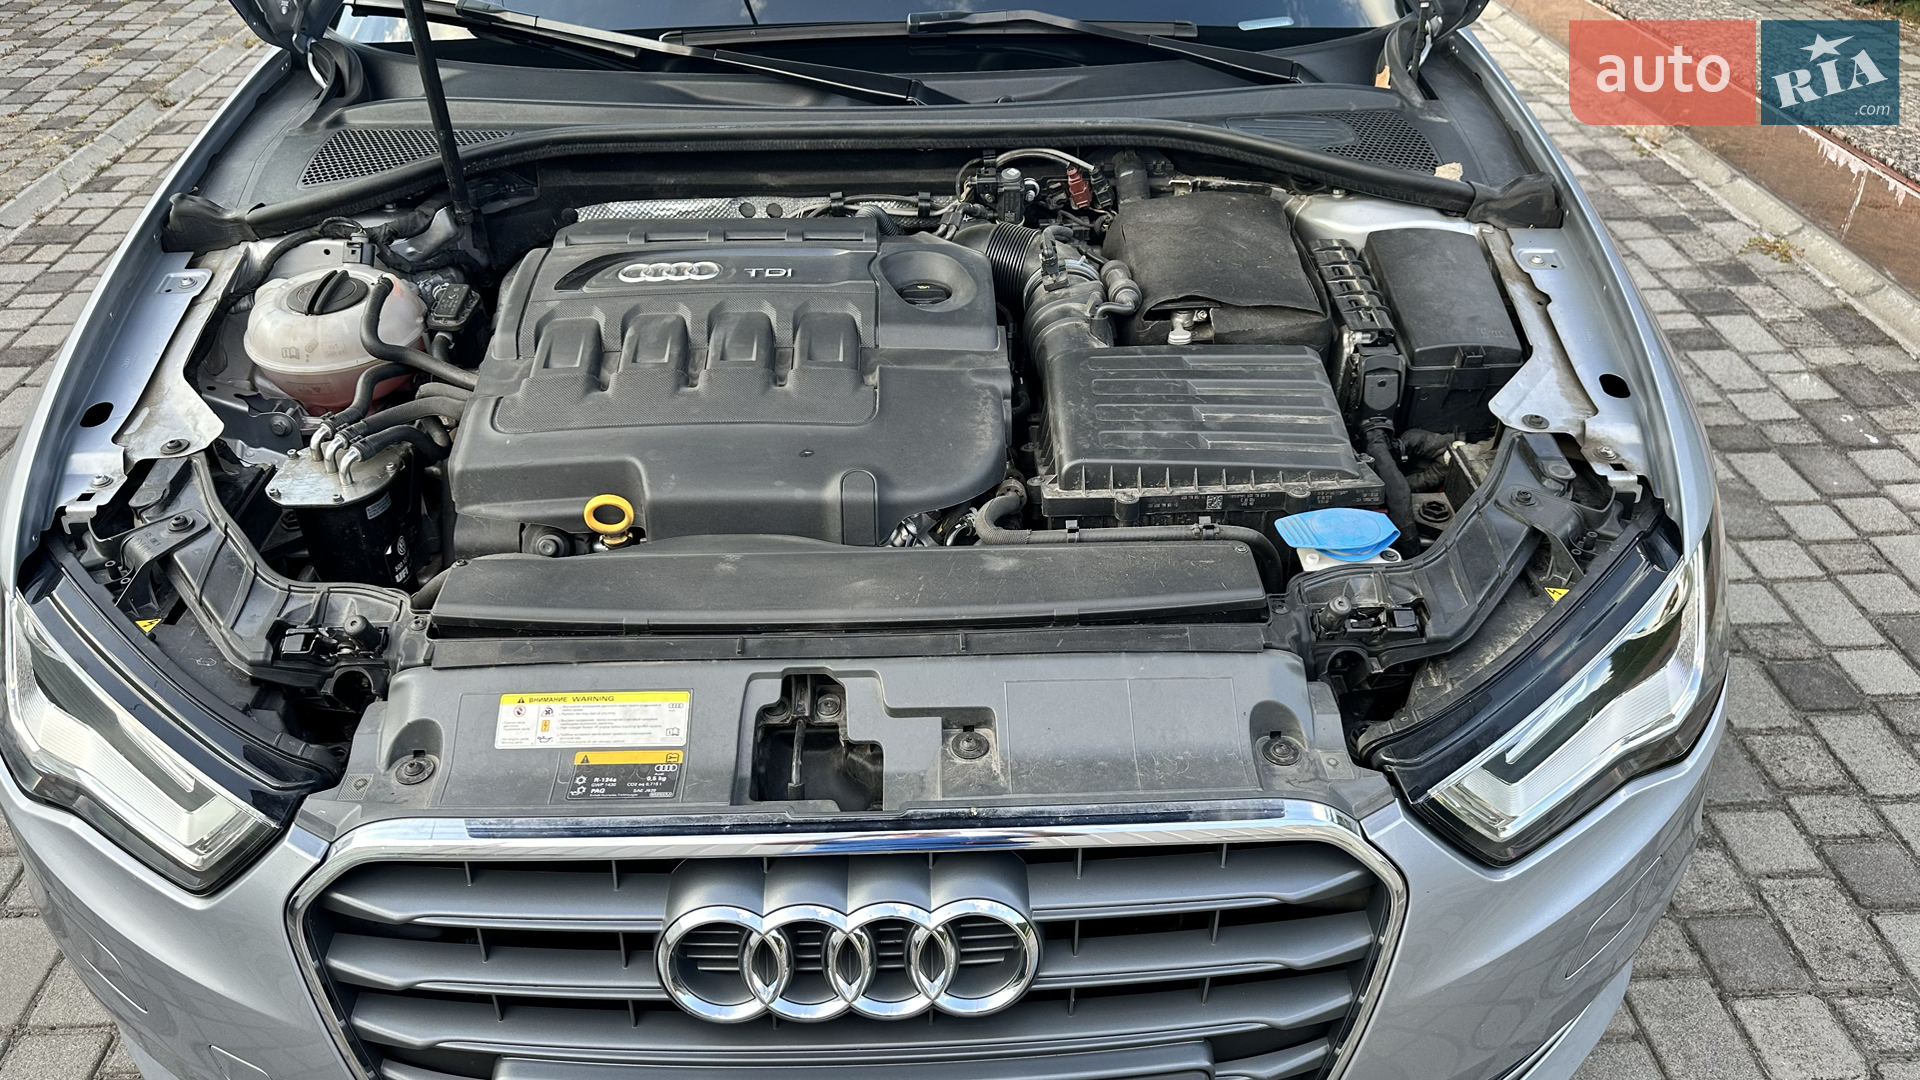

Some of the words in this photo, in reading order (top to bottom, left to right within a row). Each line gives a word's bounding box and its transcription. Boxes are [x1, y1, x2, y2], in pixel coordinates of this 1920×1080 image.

[744, 268, 792, 277] TDI
[529, 696, 568, 704] ВНИМАНИЕ
[572, 695, 615, 703] WARNING
